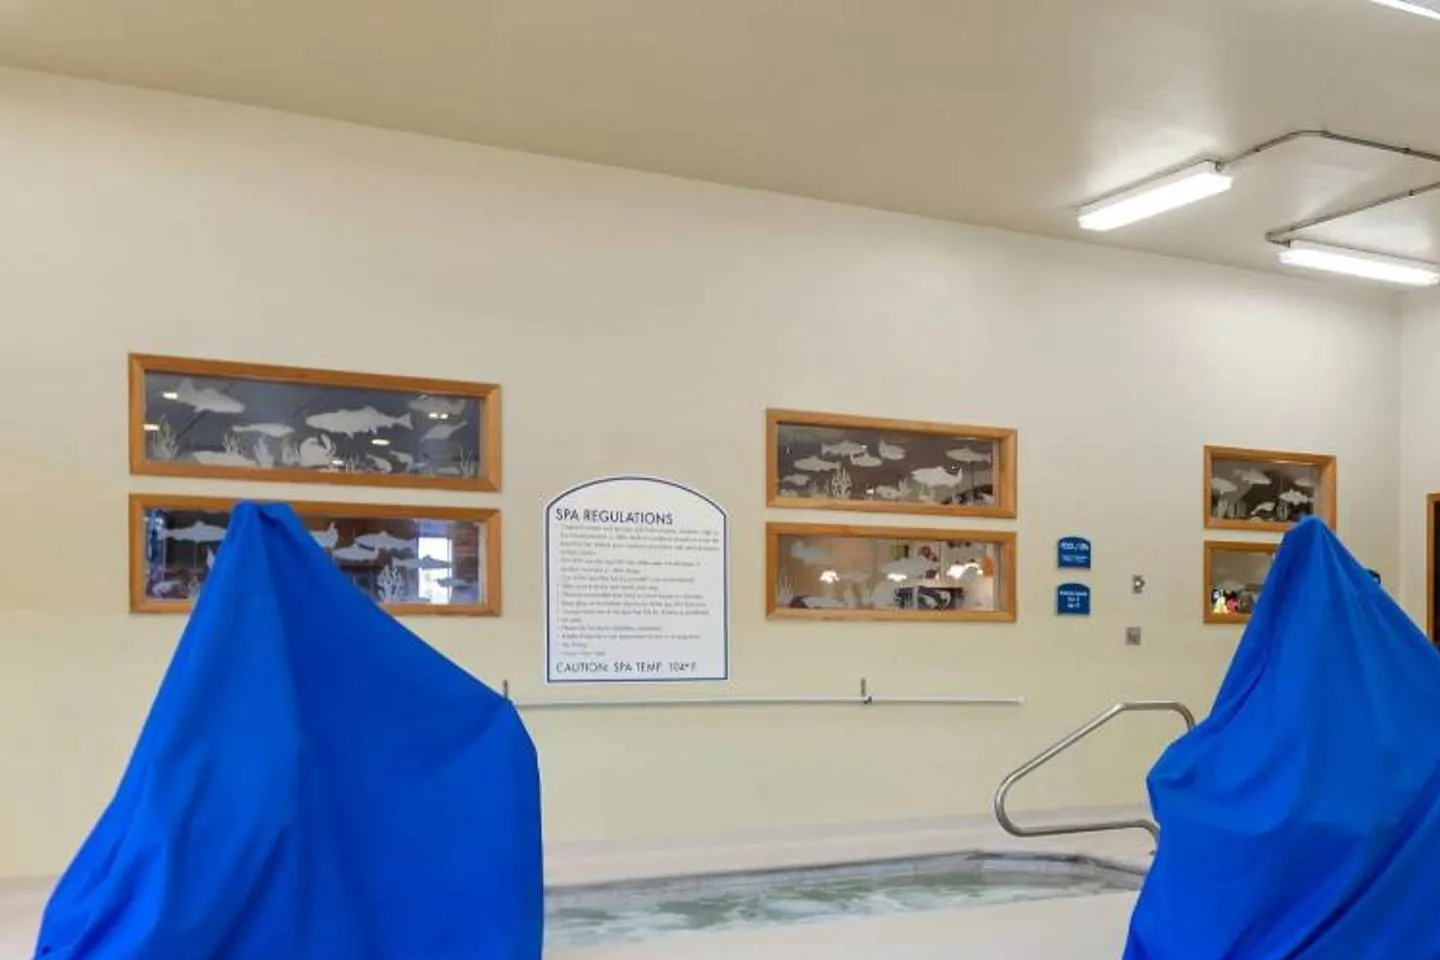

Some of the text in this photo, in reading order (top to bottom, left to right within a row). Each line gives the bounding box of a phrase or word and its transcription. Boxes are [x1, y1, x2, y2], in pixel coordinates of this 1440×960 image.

[555, 508, 674, 525] SPA REGULATIONS
[613, 661, 633, 673] SPA
